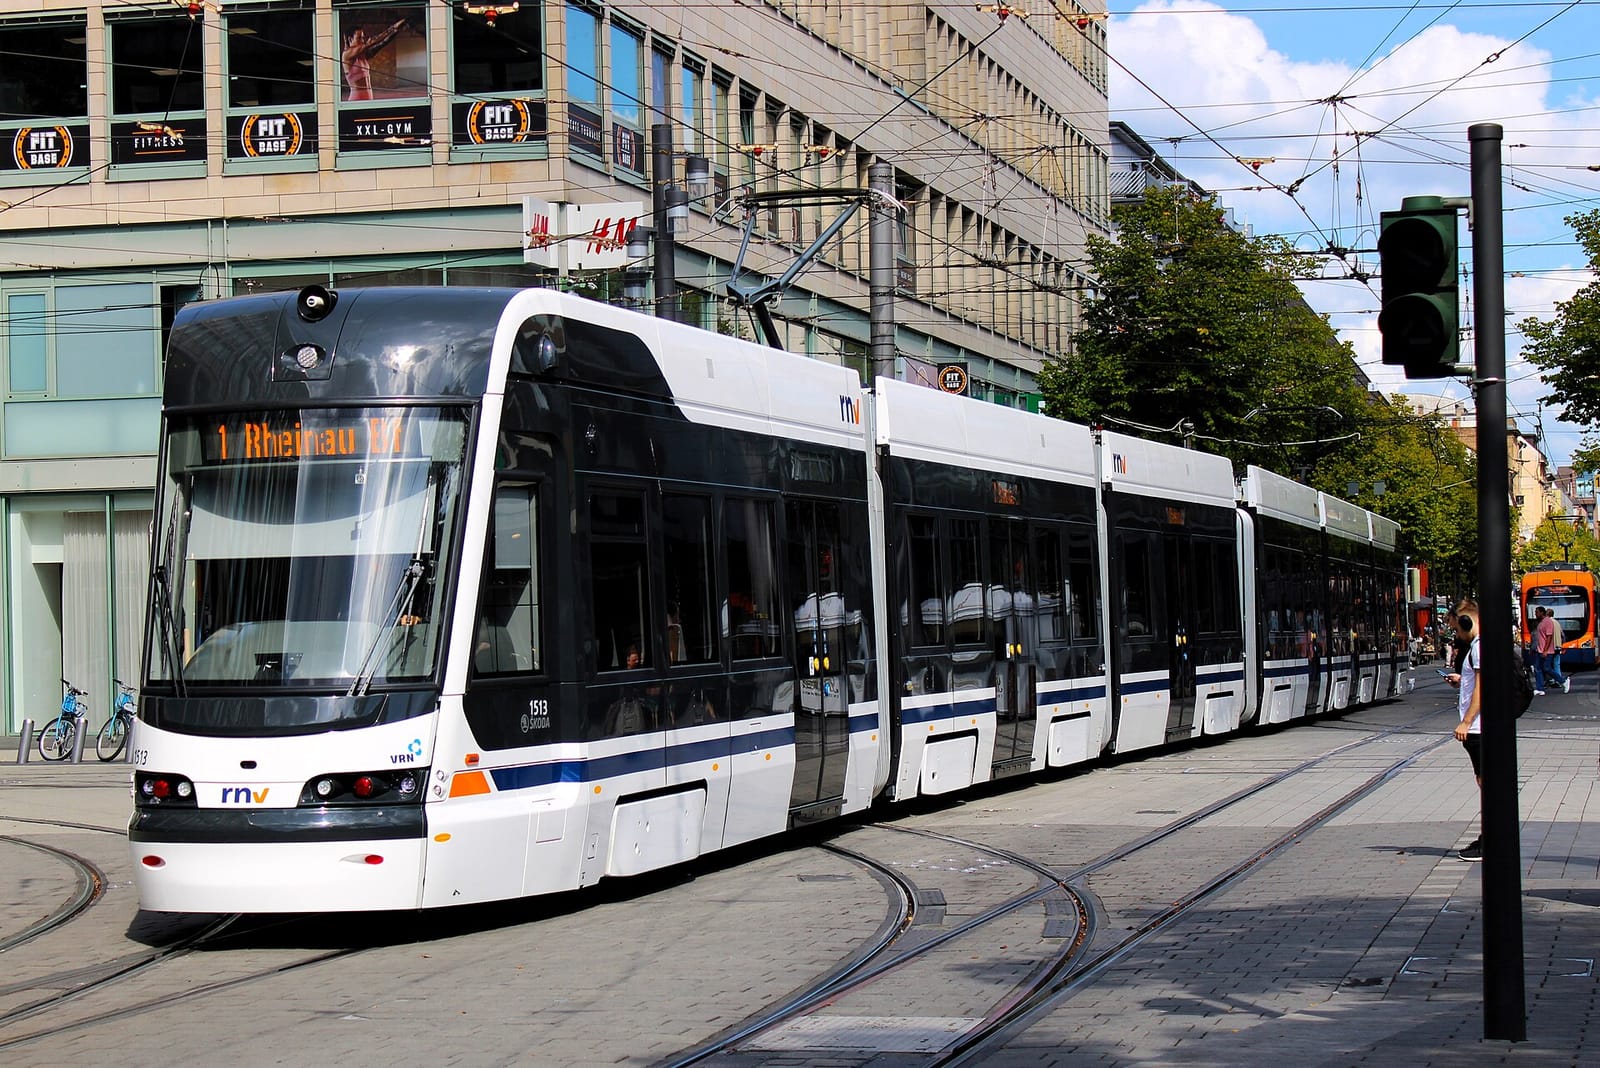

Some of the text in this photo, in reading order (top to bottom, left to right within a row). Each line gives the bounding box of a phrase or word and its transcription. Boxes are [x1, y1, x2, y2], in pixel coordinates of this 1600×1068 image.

[484, 104, 513, 124] FIT
[258, 118, 286, 137] FIT
[356, 122, 412, 136] XXL-GYM
[485, 127, 514, 140] BASE
[30, 131, 57, 150] FIT
[258, 140, 287, 153] BASE
[30, 152, 58, 165] BASE
[586, 216, 638, 255] HM
[946, 372, 960, 382] FIT
[217, 423, 228, 461] 1
[245, 421, 355, 459] Rheinau
[529, 699, 548, 716] 1513
[390, 753, 415, 764] VRN
[221, 787, 270, 804] rnv
